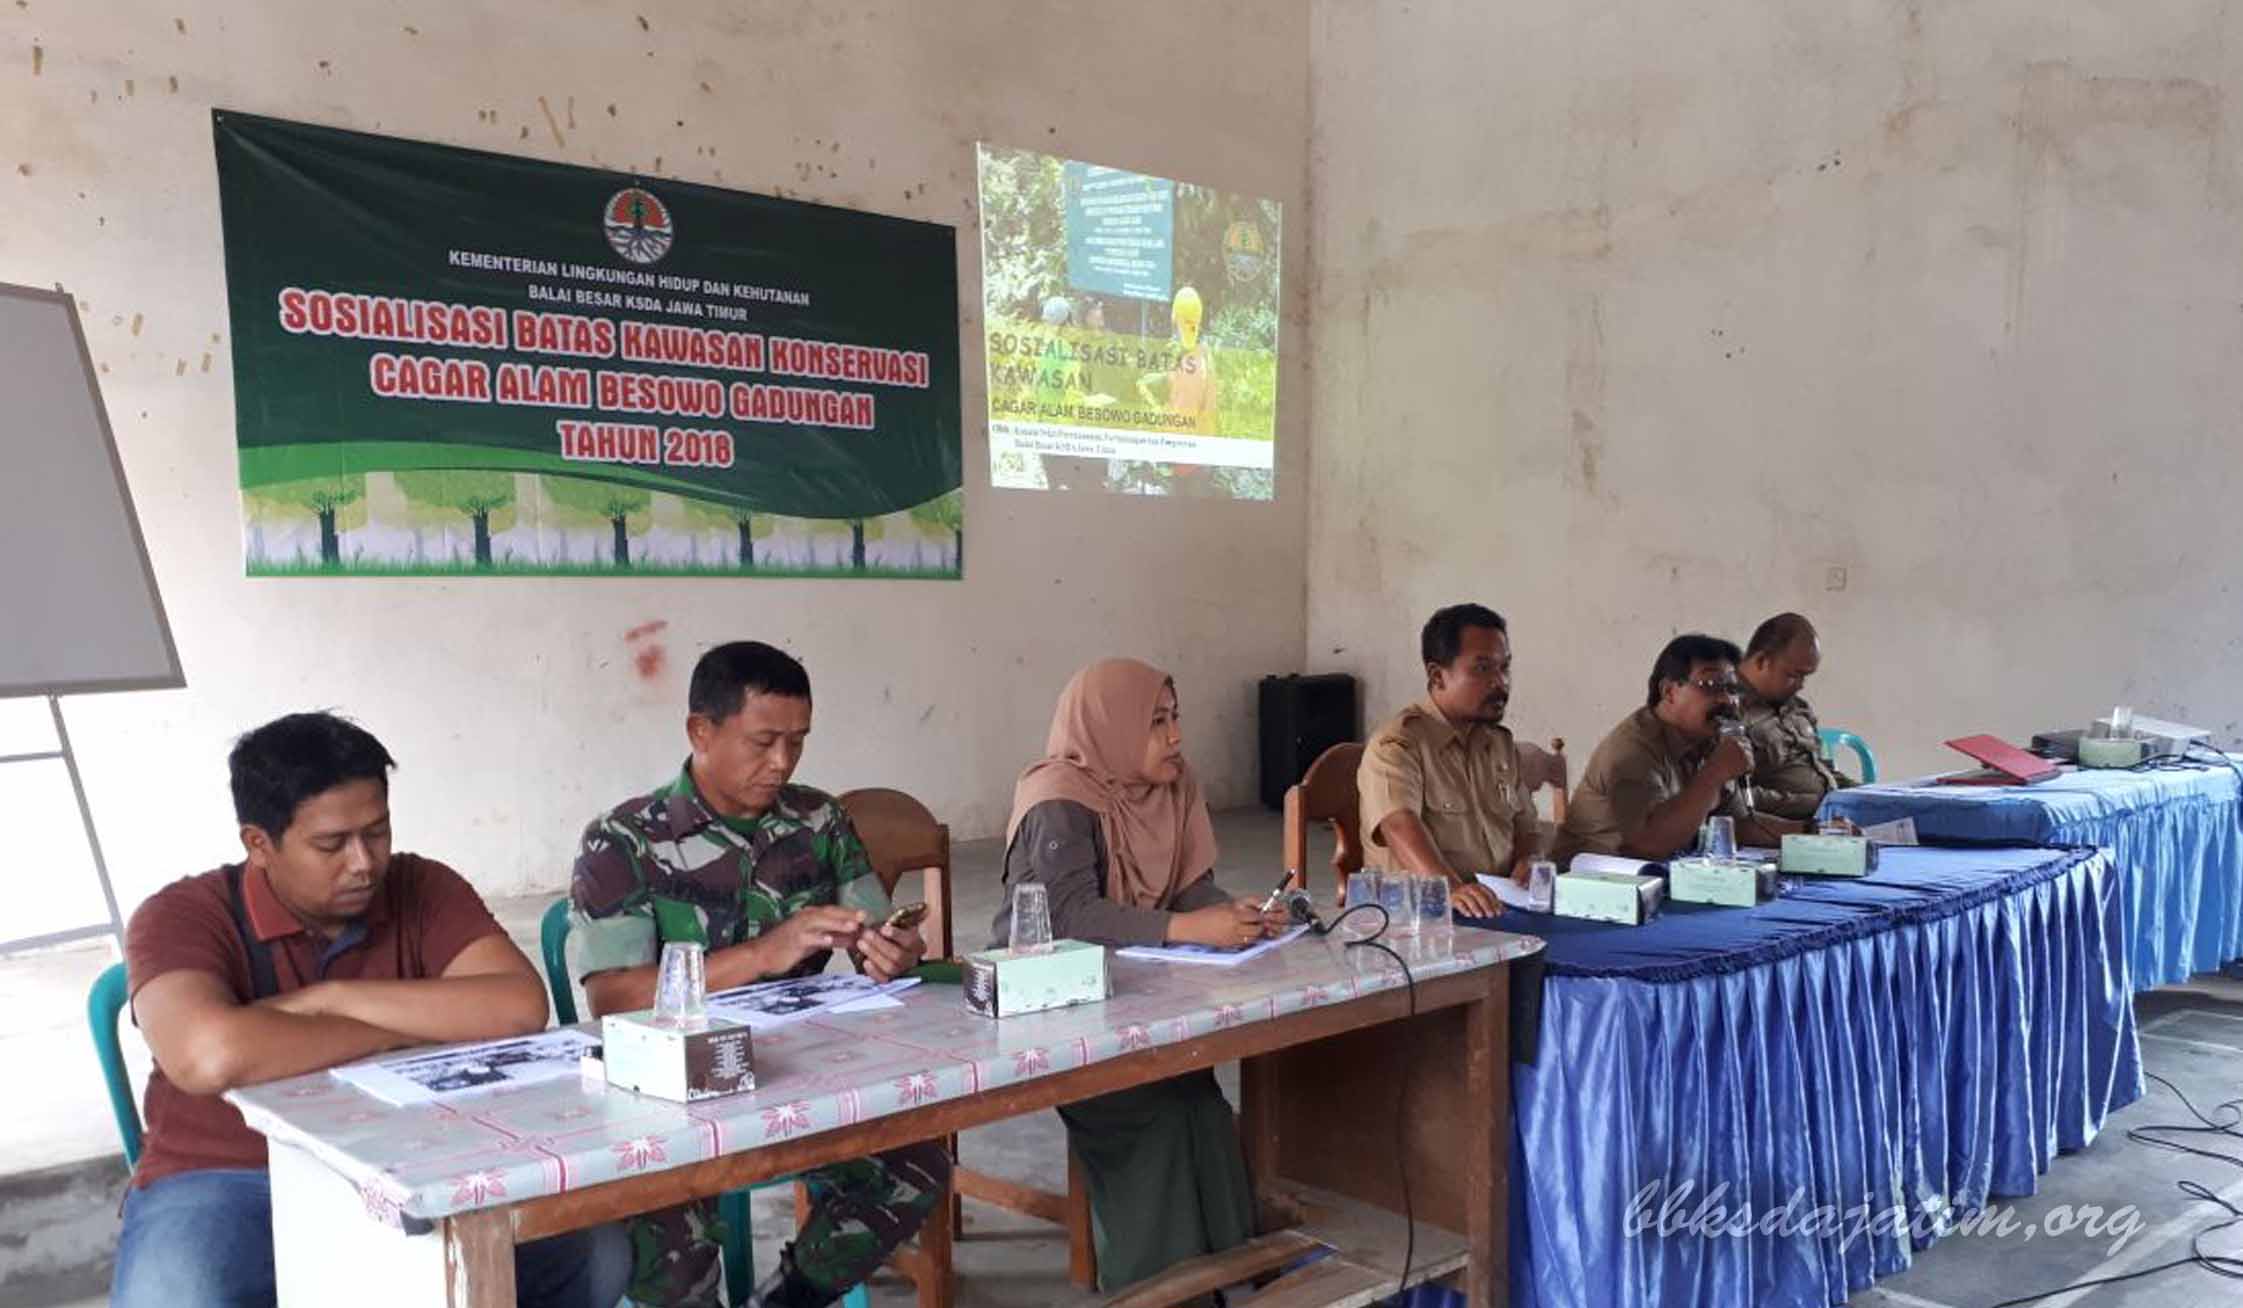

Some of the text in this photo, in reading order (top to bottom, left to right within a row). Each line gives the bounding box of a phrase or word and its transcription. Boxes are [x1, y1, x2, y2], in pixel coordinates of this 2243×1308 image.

[449, 250, 810, 305] KEMENTERIAN LINGKUNGAN HIDUP DAN KEHUTANAN
[528, 284, 748, 321] BALAI BESAR KSDA JAWA TIMUR
[280, 289, 929, 387] SOSIALISASI BATAS KAWASAN KONSERVASI
[989, 332, 1198, 375] SOSIALISASI BATAS
[371, 354, 874, 428] CAGAR ALAM BESOWO GADUNGAN
[991, 362, 1094, 392] KAWASAN
[991, 398, 1037, 416] CAGAR
[1077, 405, 1131, 424] BESOWO
[1134, 408, 1198, 429] GADUNGAN
[557, 421, 734, 467] TAHUN 2018
